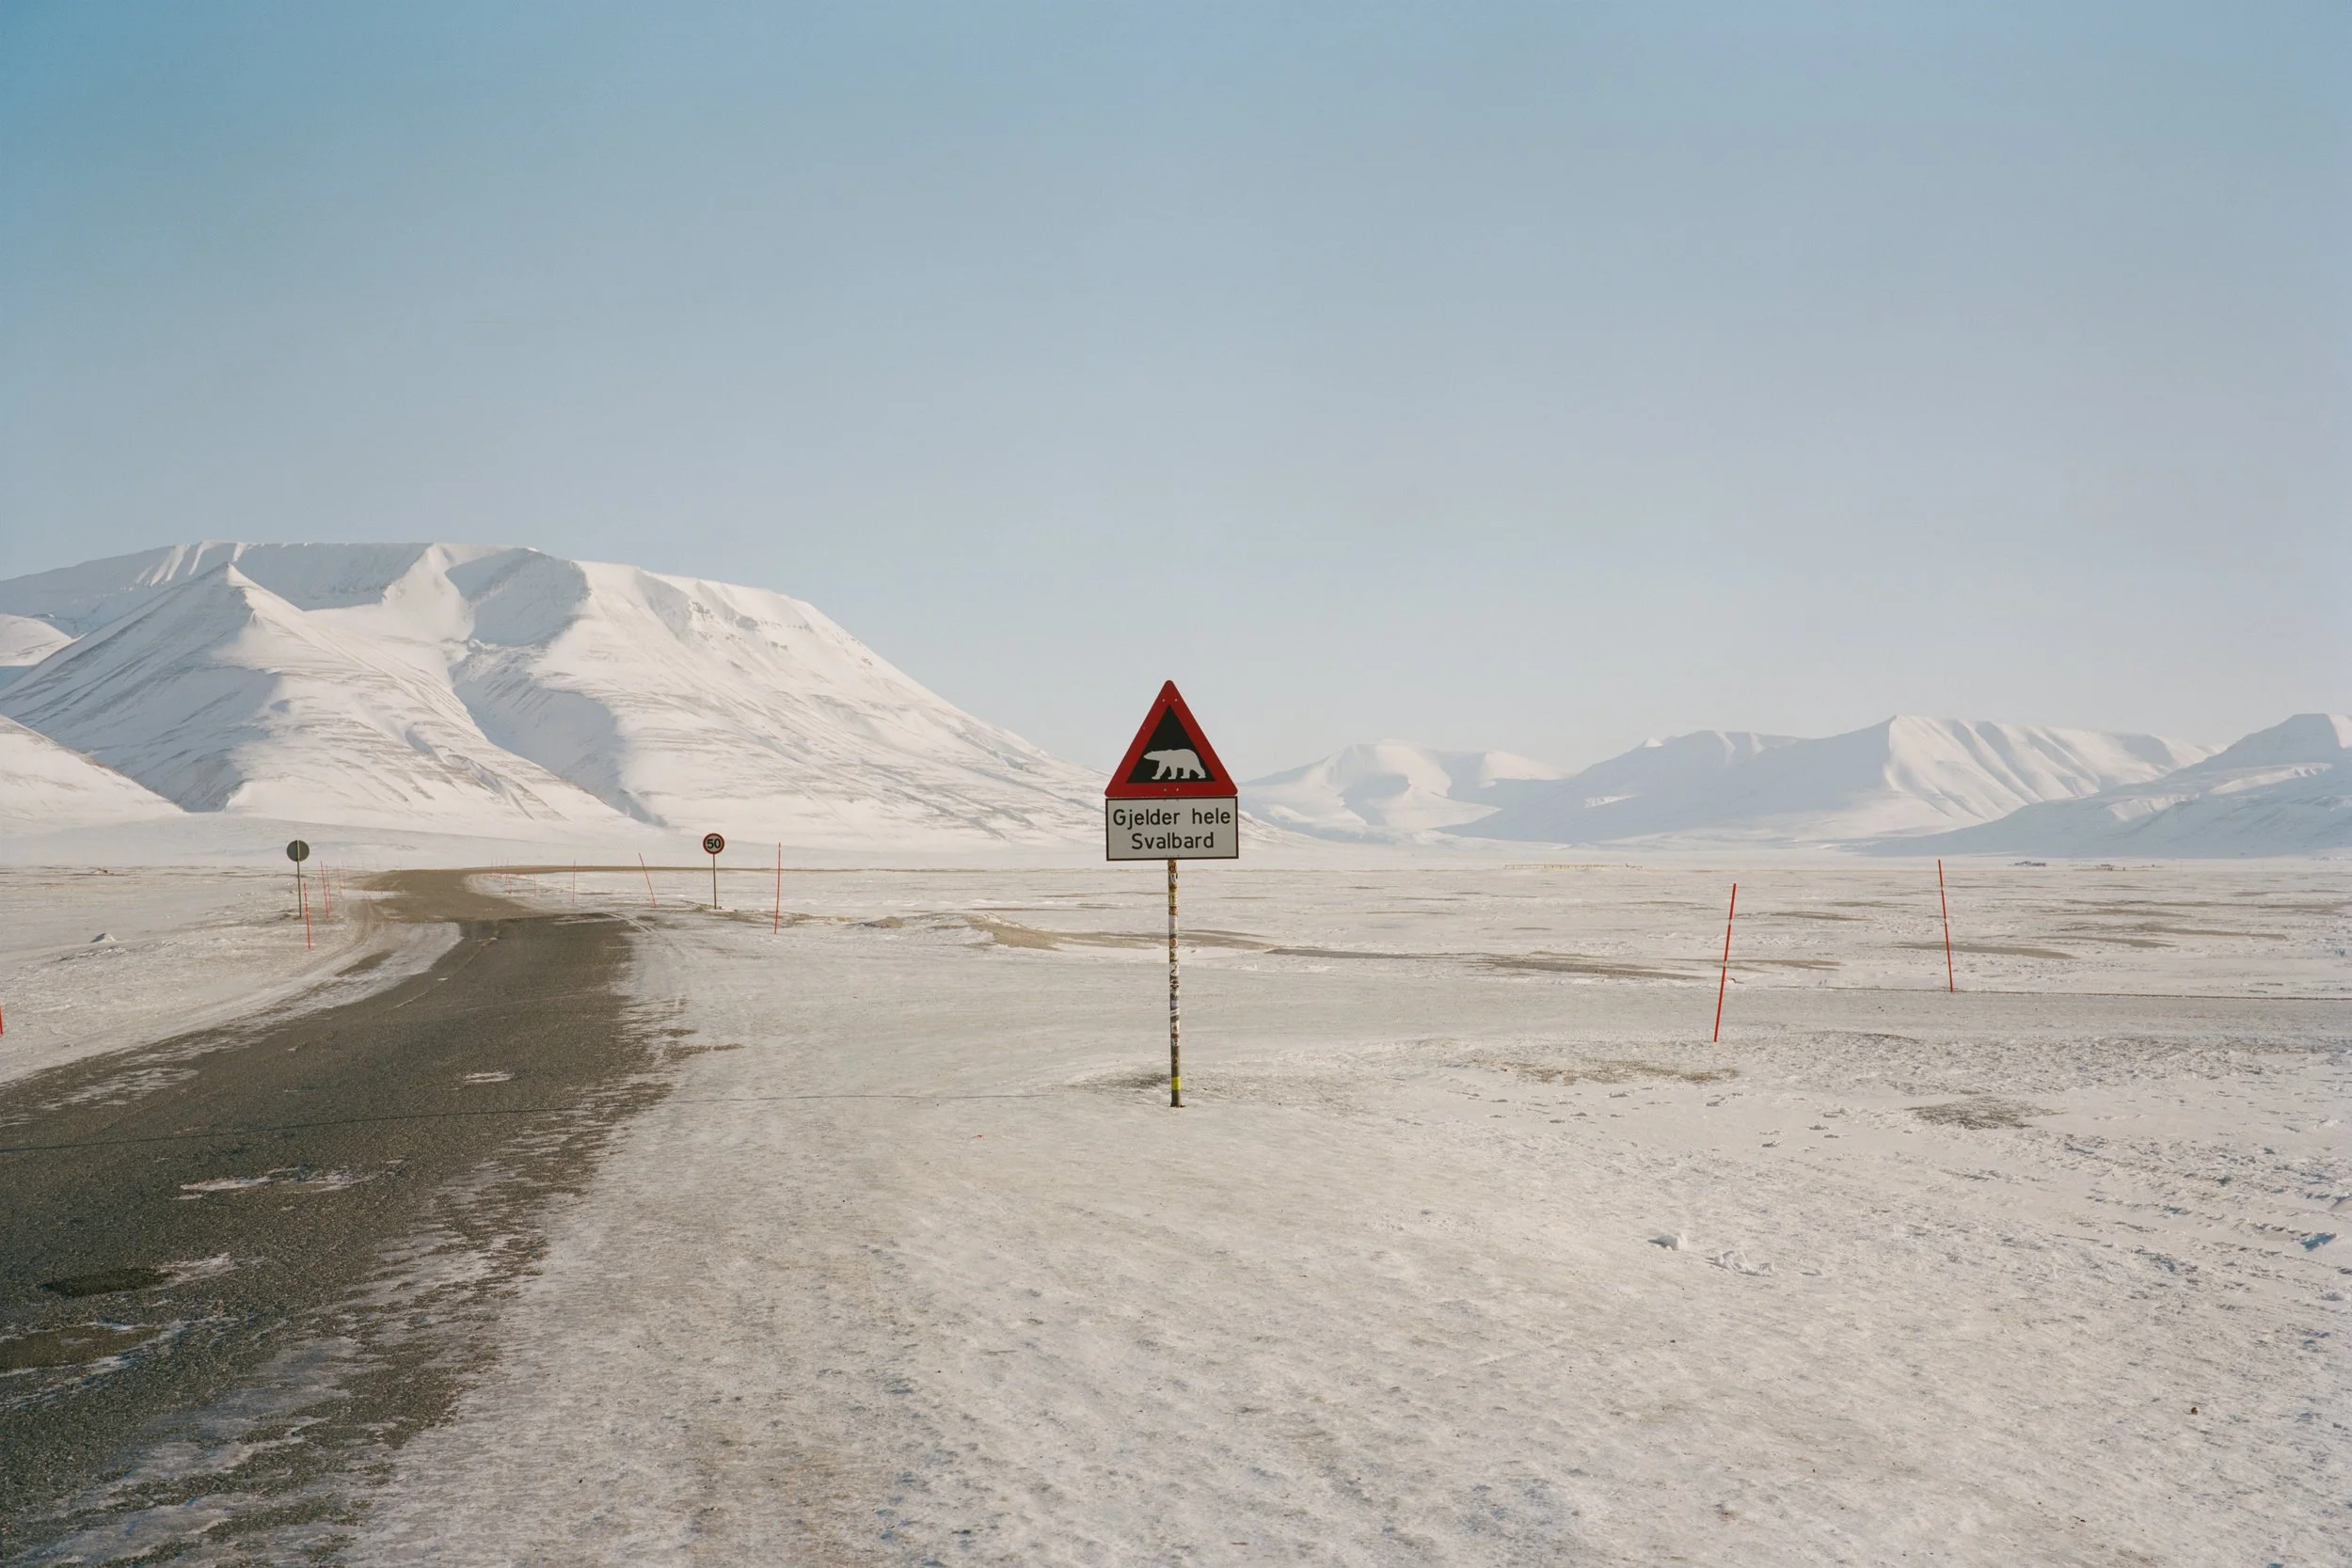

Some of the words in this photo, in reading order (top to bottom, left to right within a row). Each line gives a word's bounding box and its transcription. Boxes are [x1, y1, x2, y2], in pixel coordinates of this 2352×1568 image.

[1113, 808, 1181, 830] Gjelder
[1192, 807, 1231, 825] hele
[707, 838, 722, 849] 50
[1131, 832, 1214, 849] Svalbard
